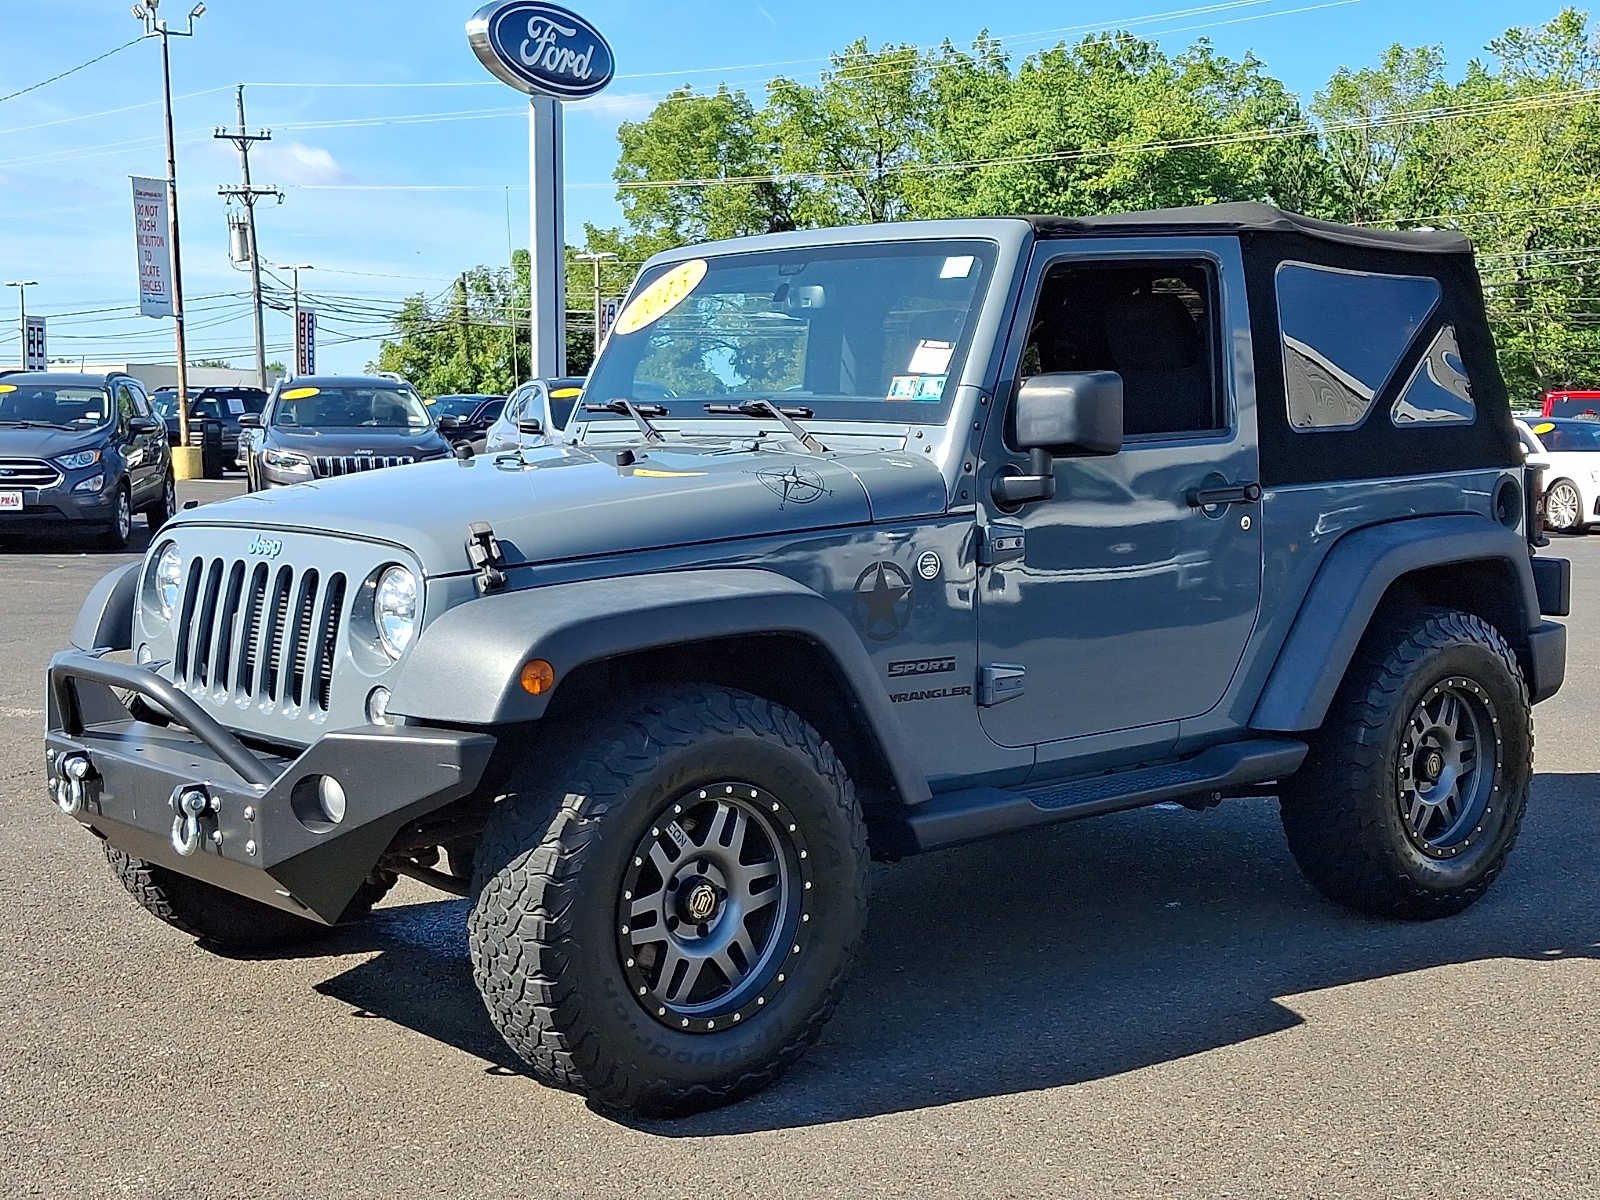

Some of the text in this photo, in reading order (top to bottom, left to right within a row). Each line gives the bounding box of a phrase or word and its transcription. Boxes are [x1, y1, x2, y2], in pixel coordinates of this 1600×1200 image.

[520, 15, 595, 80] Ford
[144, 205, 158, 217] NOT
[138, 220, 157, 232] PUSH
[248, 532, 283, 560] Jeep
[890, 660, 954, 675] SPORT
[889, 686, 972, 703] WRANGLER
